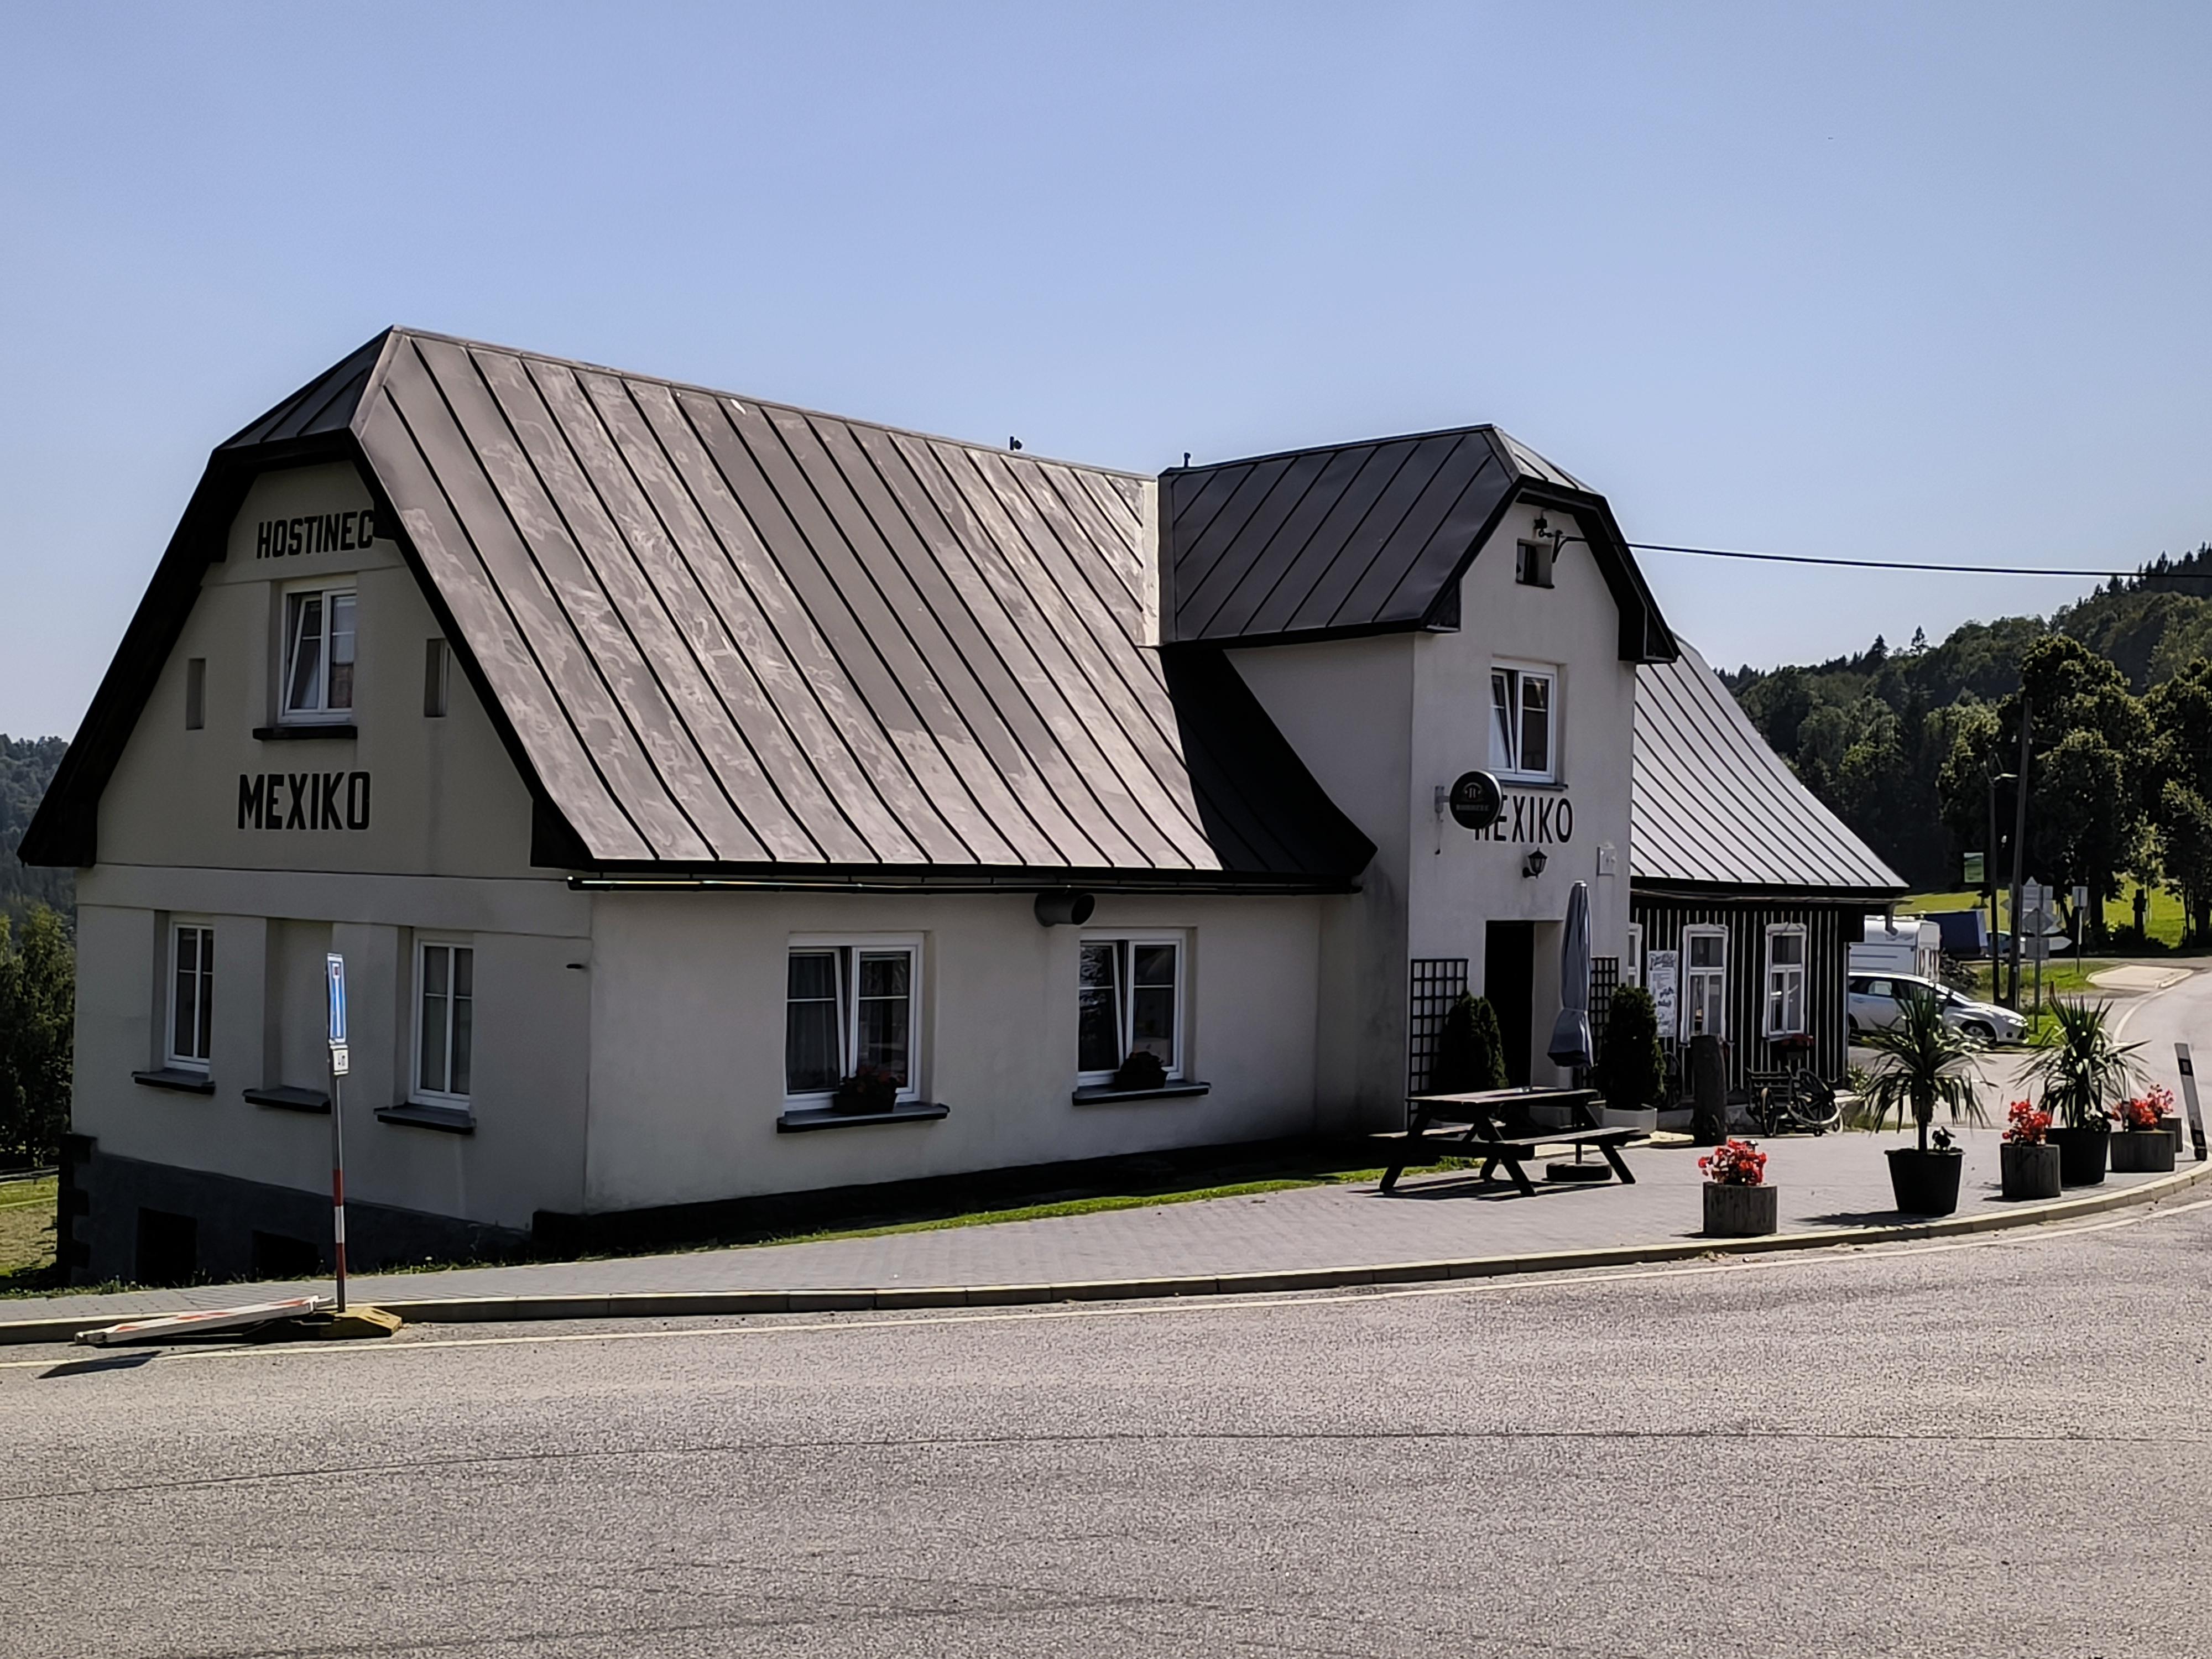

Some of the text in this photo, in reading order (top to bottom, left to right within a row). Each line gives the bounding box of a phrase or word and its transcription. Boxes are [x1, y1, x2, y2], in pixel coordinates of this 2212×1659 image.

[257, 510, 374, 559] HOSTINEC
[238, 771, 370, 830] MEXIKO
[1475, 795, 1573, 843] EXIKO
